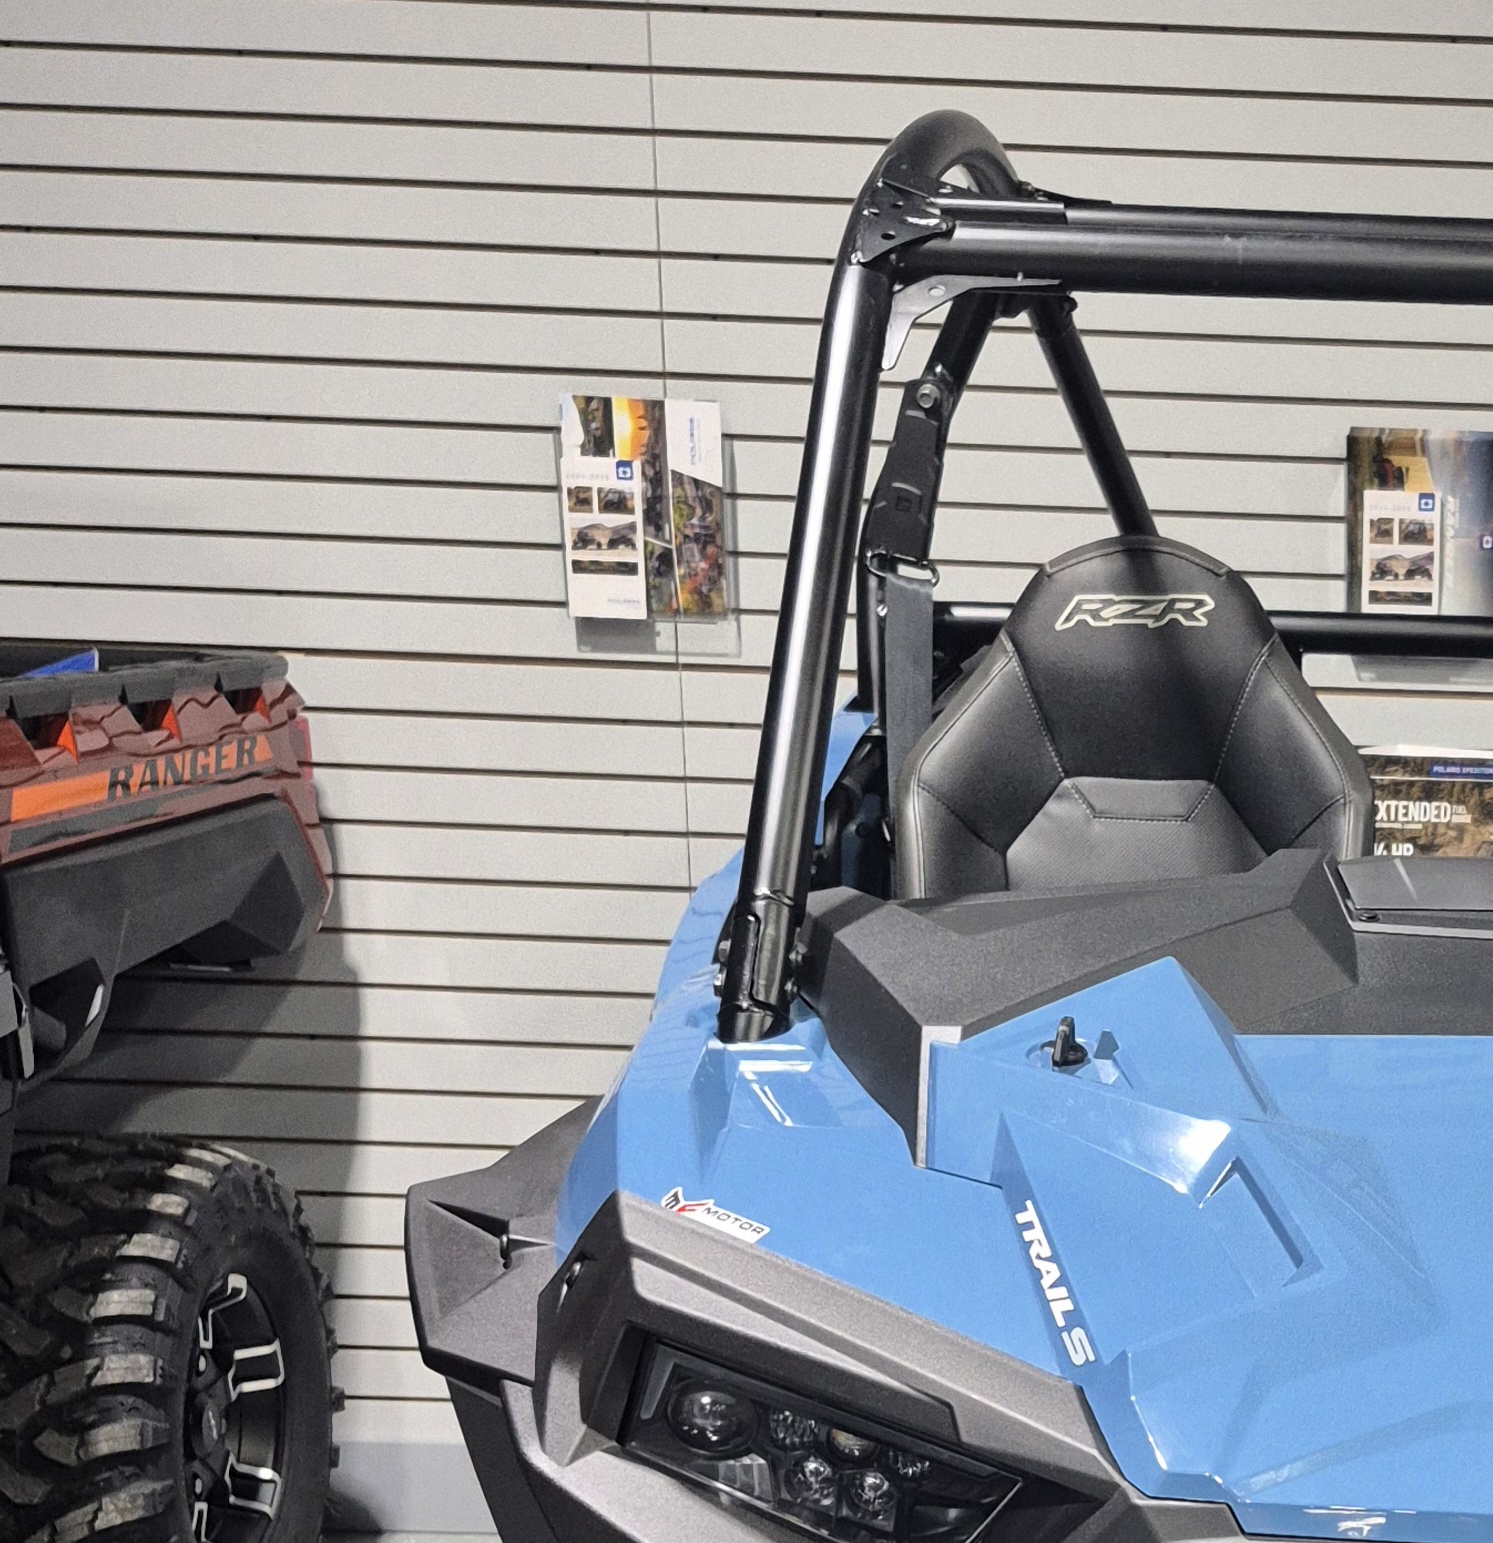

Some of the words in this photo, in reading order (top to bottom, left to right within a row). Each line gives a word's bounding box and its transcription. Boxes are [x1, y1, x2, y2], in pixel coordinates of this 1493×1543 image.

[1055, 594, 1215, 631] RZR
[107, 734, 259, 801] RANGER
[1374, 800, 1451, 823] XTENDED
[702, 1207, 766, 1235] MOTOR
